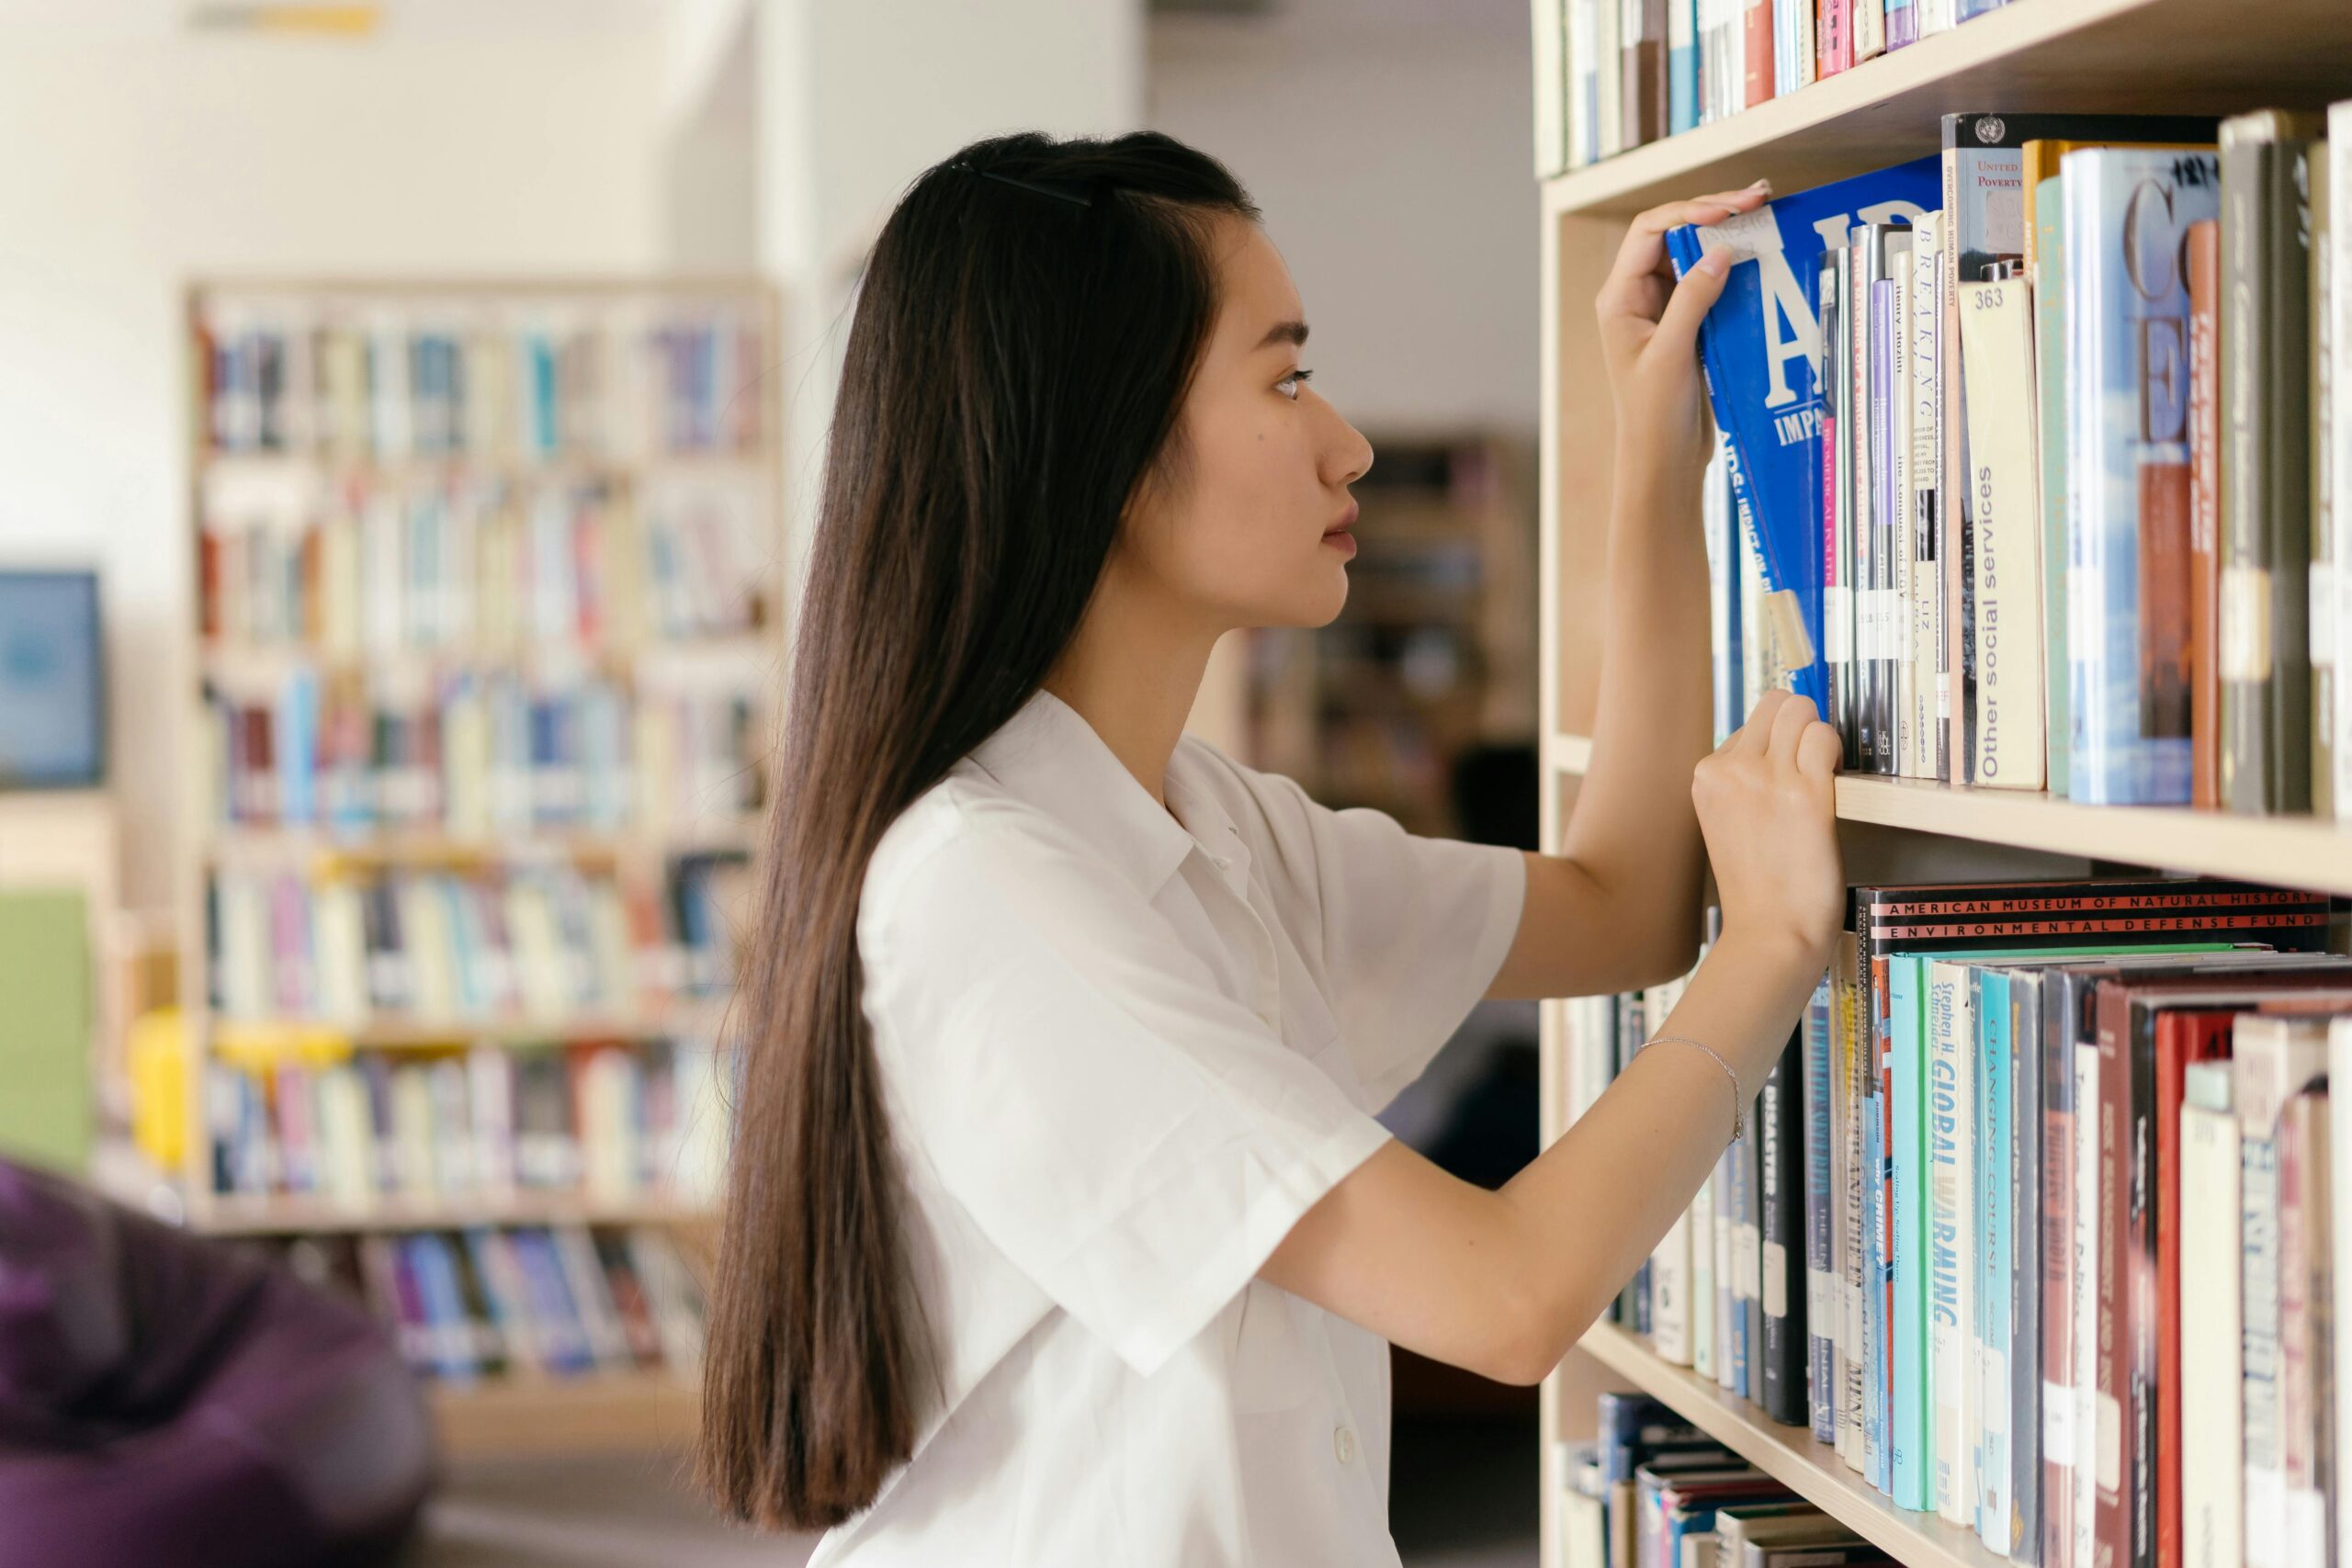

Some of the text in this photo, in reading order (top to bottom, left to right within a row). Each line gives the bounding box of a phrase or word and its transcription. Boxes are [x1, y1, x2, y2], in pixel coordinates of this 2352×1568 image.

[1977, 161, 2018, 172] United
[1977, 175, 2023, 188] Poverty
[1946, 165, 1955, 308] OVERCOMING HUMAN POVERTY
[1894, 286, 1903, 324] Henry
[1919, 228, 1933, 417] BREAKING
[1974, 286, 2004, 310] 363
[1824, 428, 1832, 520] BIOMEDICAL
[1737, 497, 1760, 549] IMPACT
[1896, 483, 1905, 544] Conquest
[1898, 549, 1907, 562] of
[1978, 467, 1998, 778] Other social services
[1889, 892, 2313, 915] AMERICAN MUSEUM OF NATURAL HISTORY
[1891, 915, 2314, 938] ENVIRONMENTAL DEFENSE FUND
[1931, 984, 1941, 1052] Schneider
[1940, 981, 1955, 1055] Stephen H.
[1987, 1018, 1996, 1164] CHANGING
[2012, 1058, 2020, 1138] Economics
[1764, 1085, 1778, 1196] DISASTER
[2012, 1156, 2020, 1180] the
[1848, 1162, 1860, 1210] AND
[1931, 1058, 1957, 1327] GLOBAL WARMING
[1848, 1211, 1860, 1259] THE
[1875, 1189, 1883, 1266] CRIME?
[1987, 1172, 1996, 1279] COURSE
[2012, 1182, 2020, 1270] Environment
